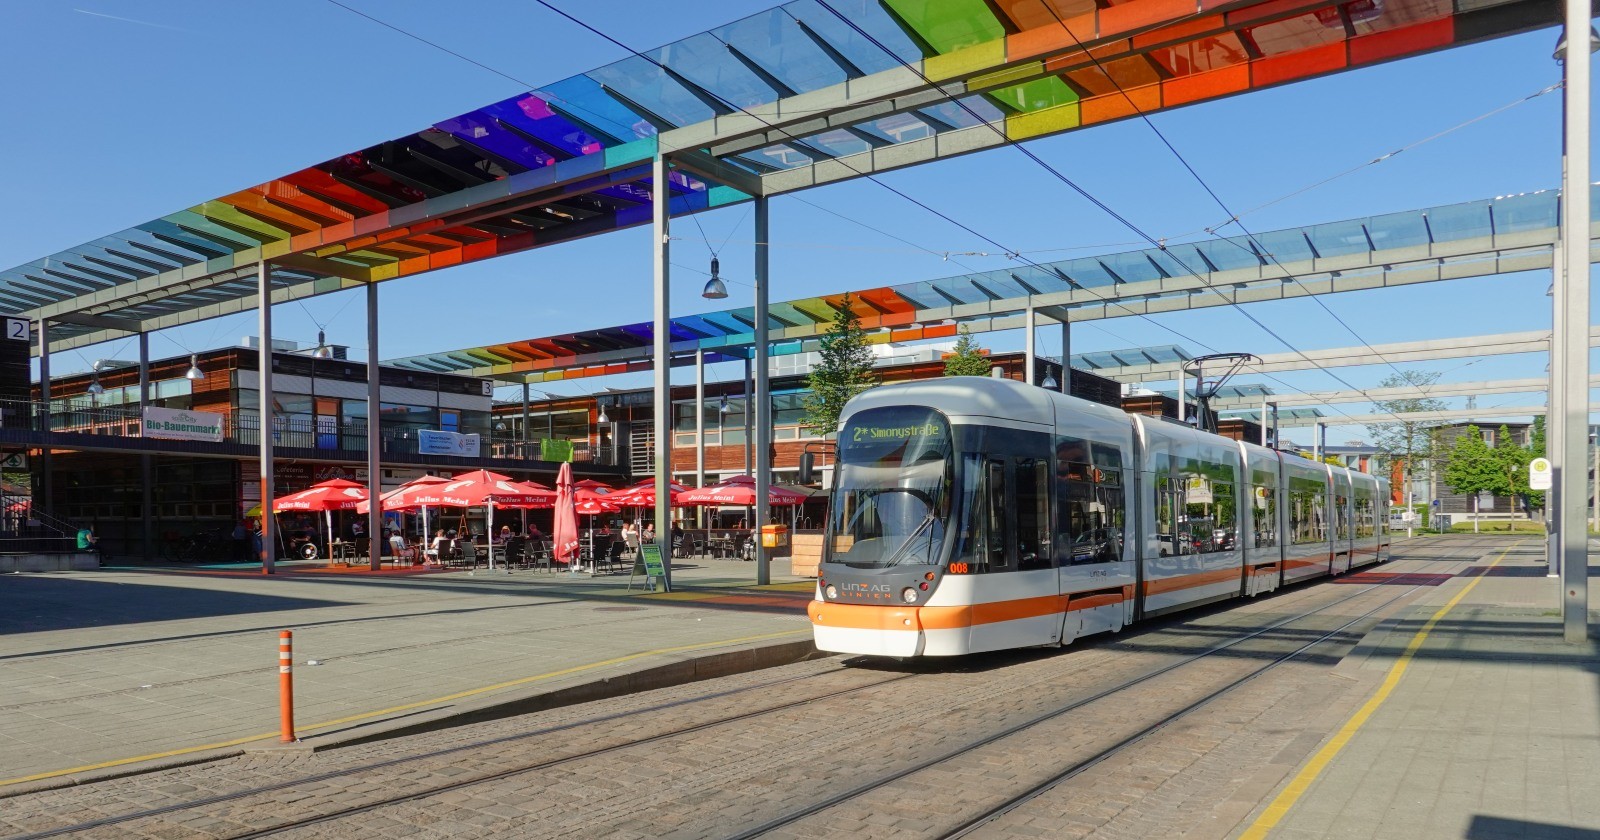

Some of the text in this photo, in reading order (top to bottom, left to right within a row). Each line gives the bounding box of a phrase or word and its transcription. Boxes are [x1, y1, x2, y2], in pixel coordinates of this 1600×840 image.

[12, 322, 25, 338] 2
[484, 382, 491, 394] 3
[870, 424, 939, 439] Simonystraße
[294, 501, 310, 509] Meinl
[414, 496, 469, 505] Julius Meinl
[950, 562, 968, 574] 008
[871, 584, 891, 592] AG
[841, 591, 892, 599] LINIEN
